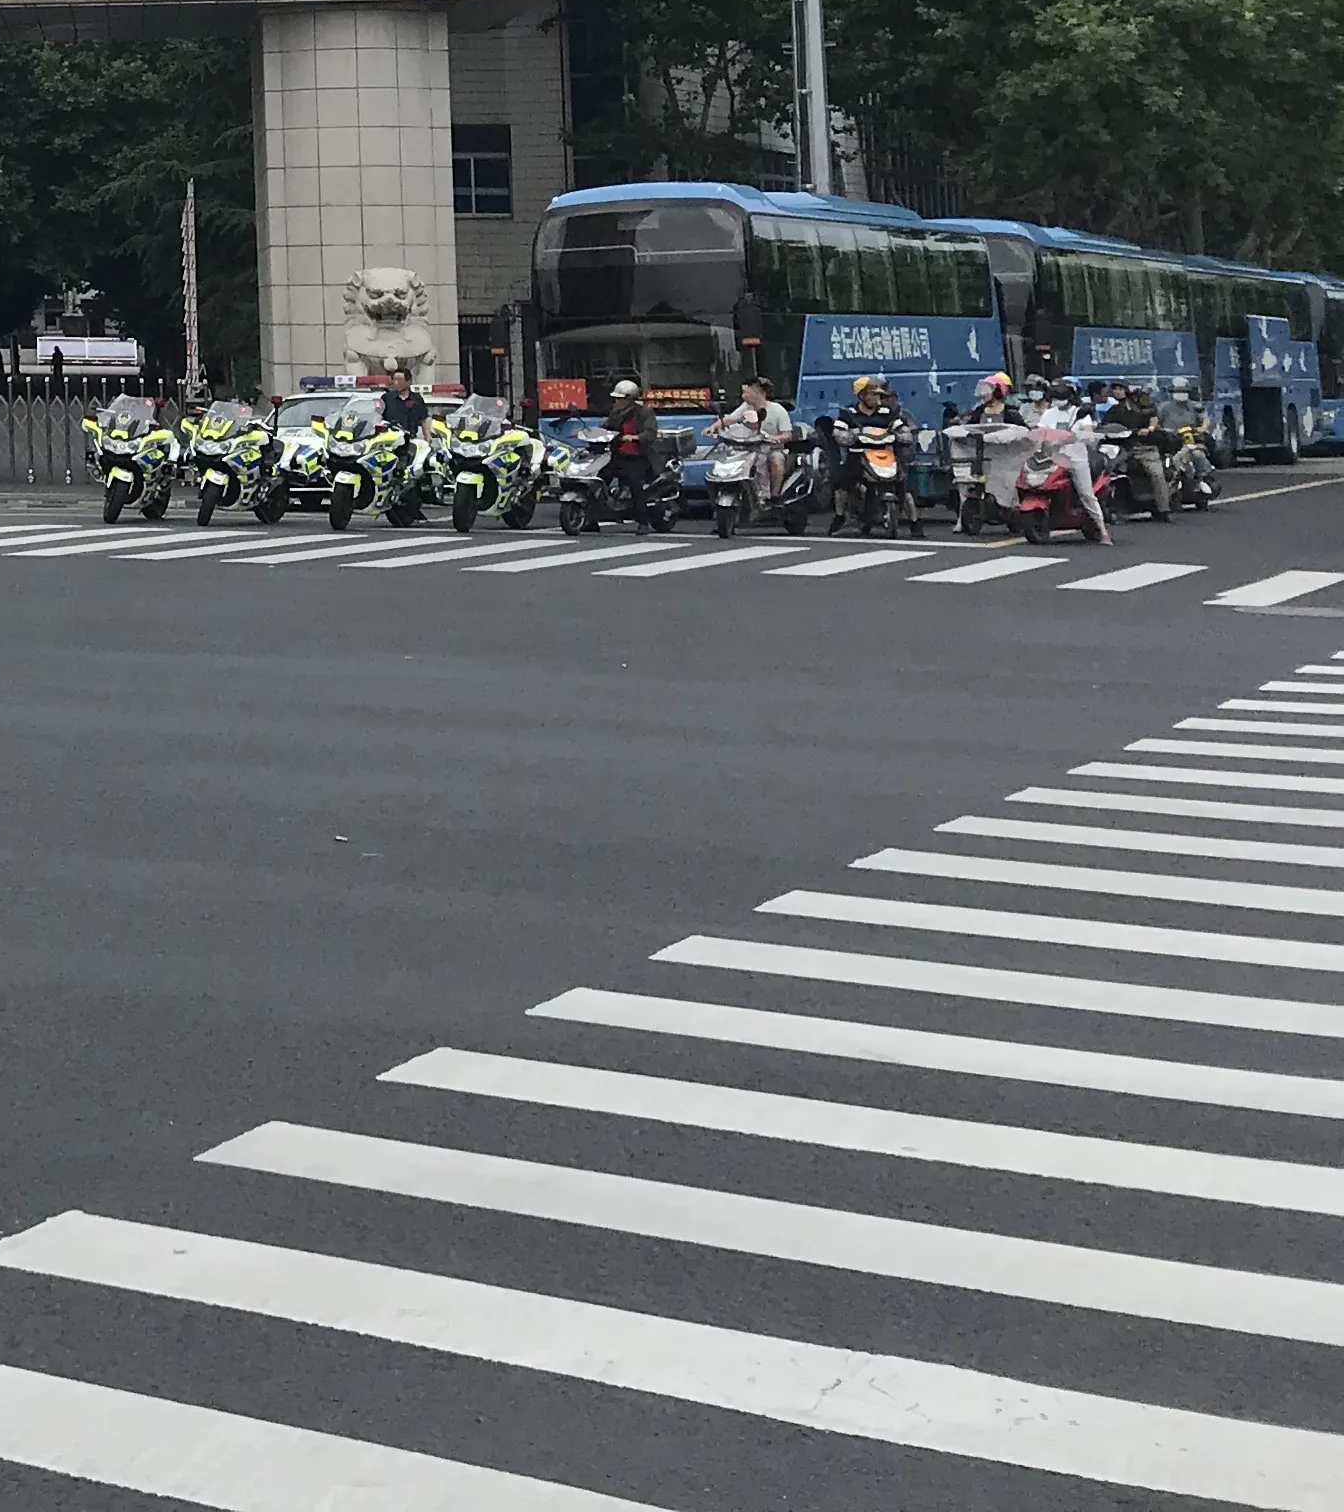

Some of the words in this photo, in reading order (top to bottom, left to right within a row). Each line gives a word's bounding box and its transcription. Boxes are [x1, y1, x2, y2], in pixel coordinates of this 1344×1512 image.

[830, 325, 931, 360] 金坛公路运输有限公司
